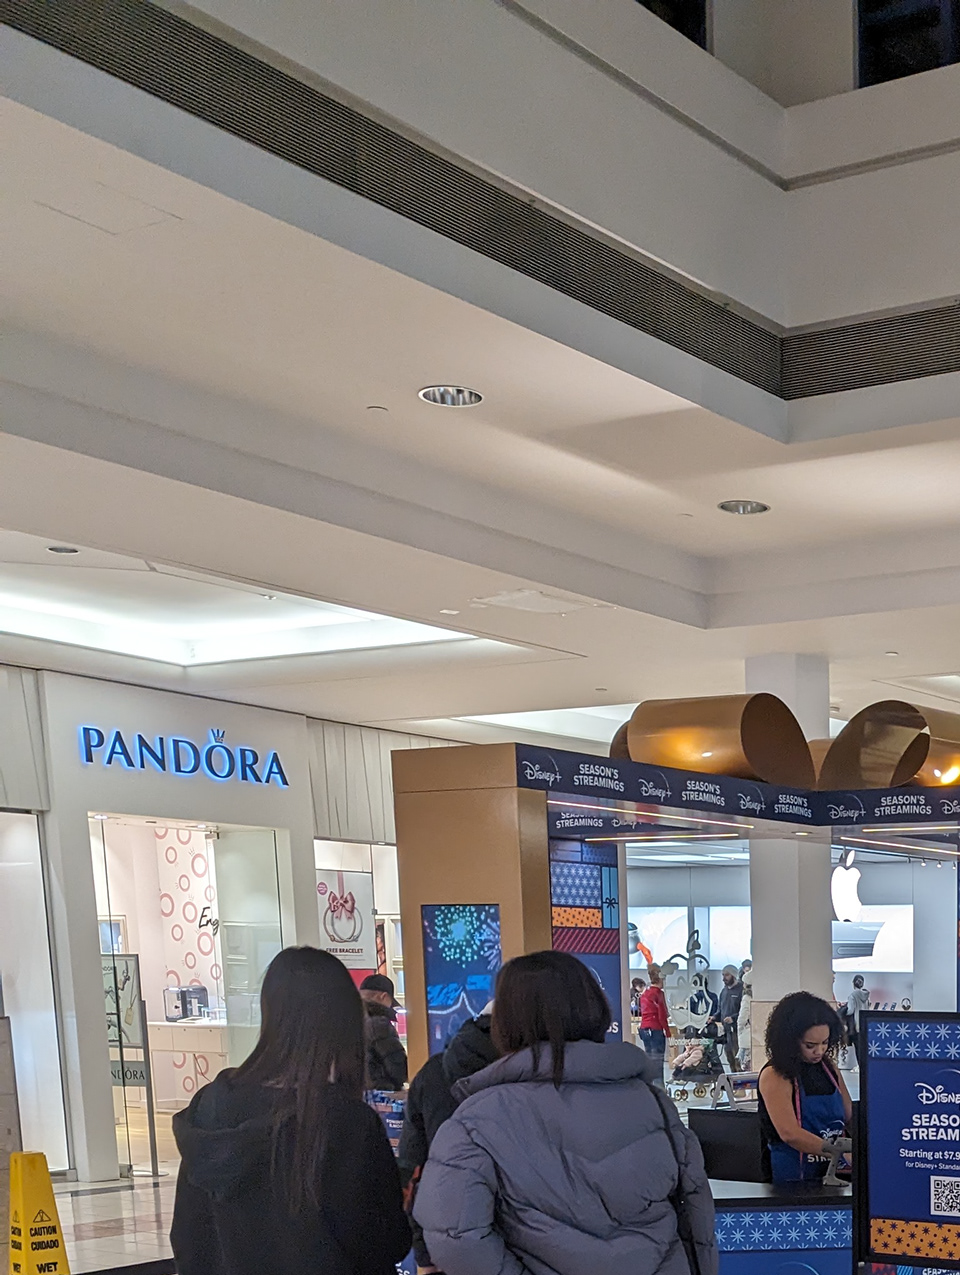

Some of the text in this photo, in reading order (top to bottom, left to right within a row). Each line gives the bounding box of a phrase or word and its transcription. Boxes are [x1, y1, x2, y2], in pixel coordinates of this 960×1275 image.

[81, 726, 290, 787] PANDORA
[522, 761, 562, 787] Disney+
[578, 763, 619, 780] SEASON'S
[573, 774, 625, 793] STREAMINGS
[638, 778, 672, 802] Disney+
[686, 780, 721, 795] SEASON'S
[681, 790, 726, 806] STREAMINGS
[737, 792, 766, 815] Disney+
[778, 793, 808, 808] SEASON'S
[880, 795, 926, 807] SEASON'S
[774, 803, 812, 819] STREAMINGS
[827, 803, 867, 822] Disney+
[874, 804, 932, 817] STREAMINGS
[556, 819, 603, 829] STREAMINGS
[899, 1148, 934, 1160] Starting
[934, 1151, 943, 1159] at
[914, 1161, 938, 1170] Disney+
[29, 1225, 57, 1238] CAUTION
[31, 1239, 60, 1252] CUIDADO
[36, 1262, 58, 1274] WET
